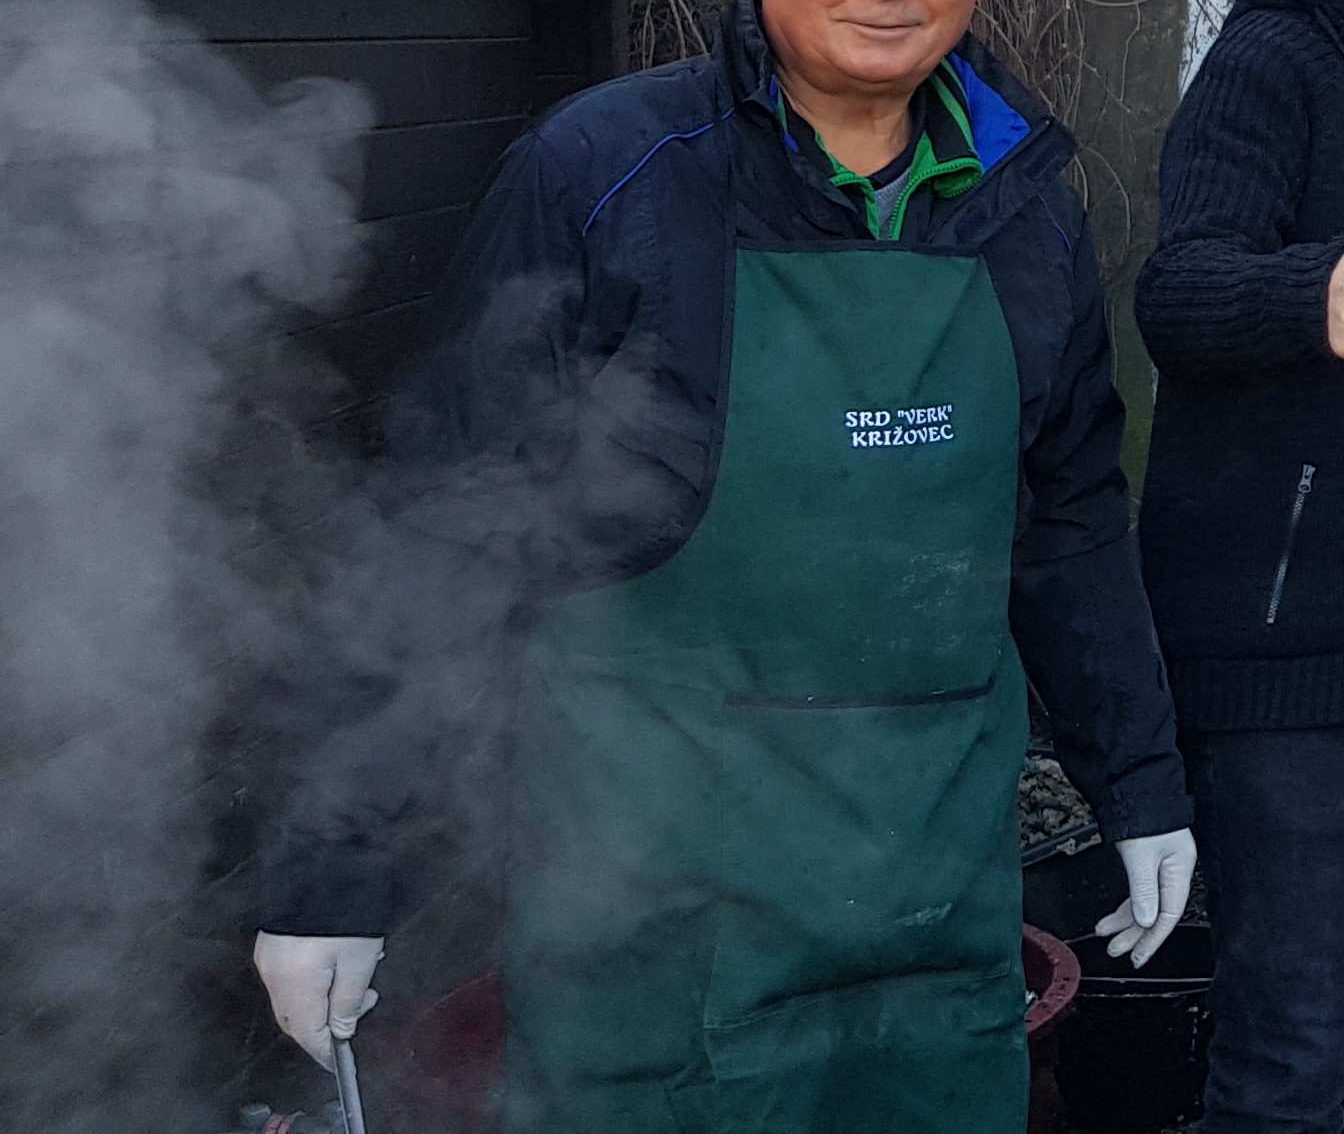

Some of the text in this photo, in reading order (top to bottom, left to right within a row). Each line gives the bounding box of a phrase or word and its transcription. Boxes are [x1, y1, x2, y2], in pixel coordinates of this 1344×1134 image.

[846, 404, 953, 427] SRD "VERK"
[852, 424, 954, 447] KRIŽOVEC
